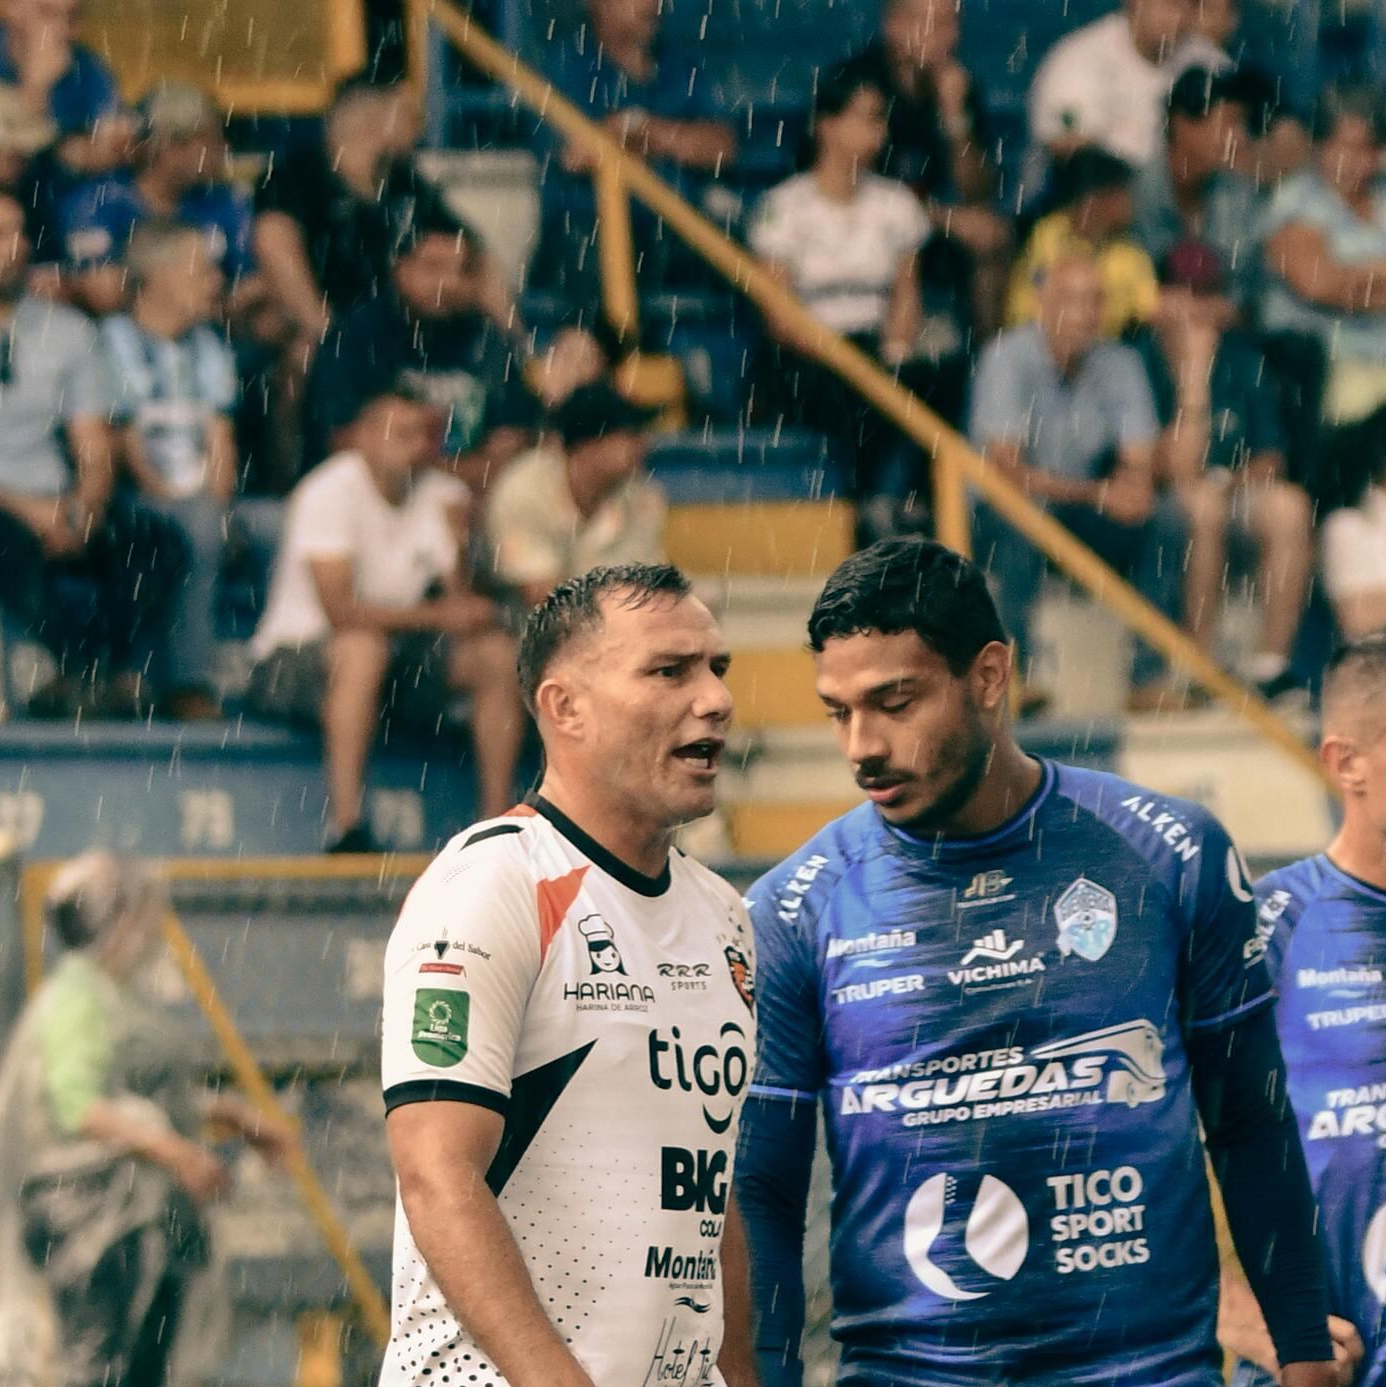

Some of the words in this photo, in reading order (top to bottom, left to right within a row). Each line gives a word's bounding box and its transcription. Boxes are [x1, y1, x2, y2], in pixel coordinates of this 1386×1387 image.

[1122, 795, 1201, 862] ALKEN
[777, 854, 829, 924] ALKEN
[657, 963, 712, 978] RRR
[671, 980, 707, 991] SPORTS
[947, 957, 1046, 987] VICHIMA
[564, 983, 656, 1004] HARIANA
[576, 1003, 609, 1012] HARINA
[830, 974, 926, 1006] TRUPER
[648, 1025, 747, 1097] tigo
[851, 1046, 1024, 1083] TRANSPORTES
[841, 1055, 1109, 1116] ARGUEDAS
[903, 1106, 970, 1127] GRUPO
[973, 1090, 1104, 1120] EMPRESARIAL
[660, 1147, 728, 1215] BIG
[1046, 1166, 1143, 1210] TICO
[1050, 1205, 1145, 1242] SPORT
[1055, 1238, 1150, 1275] SOCKS
